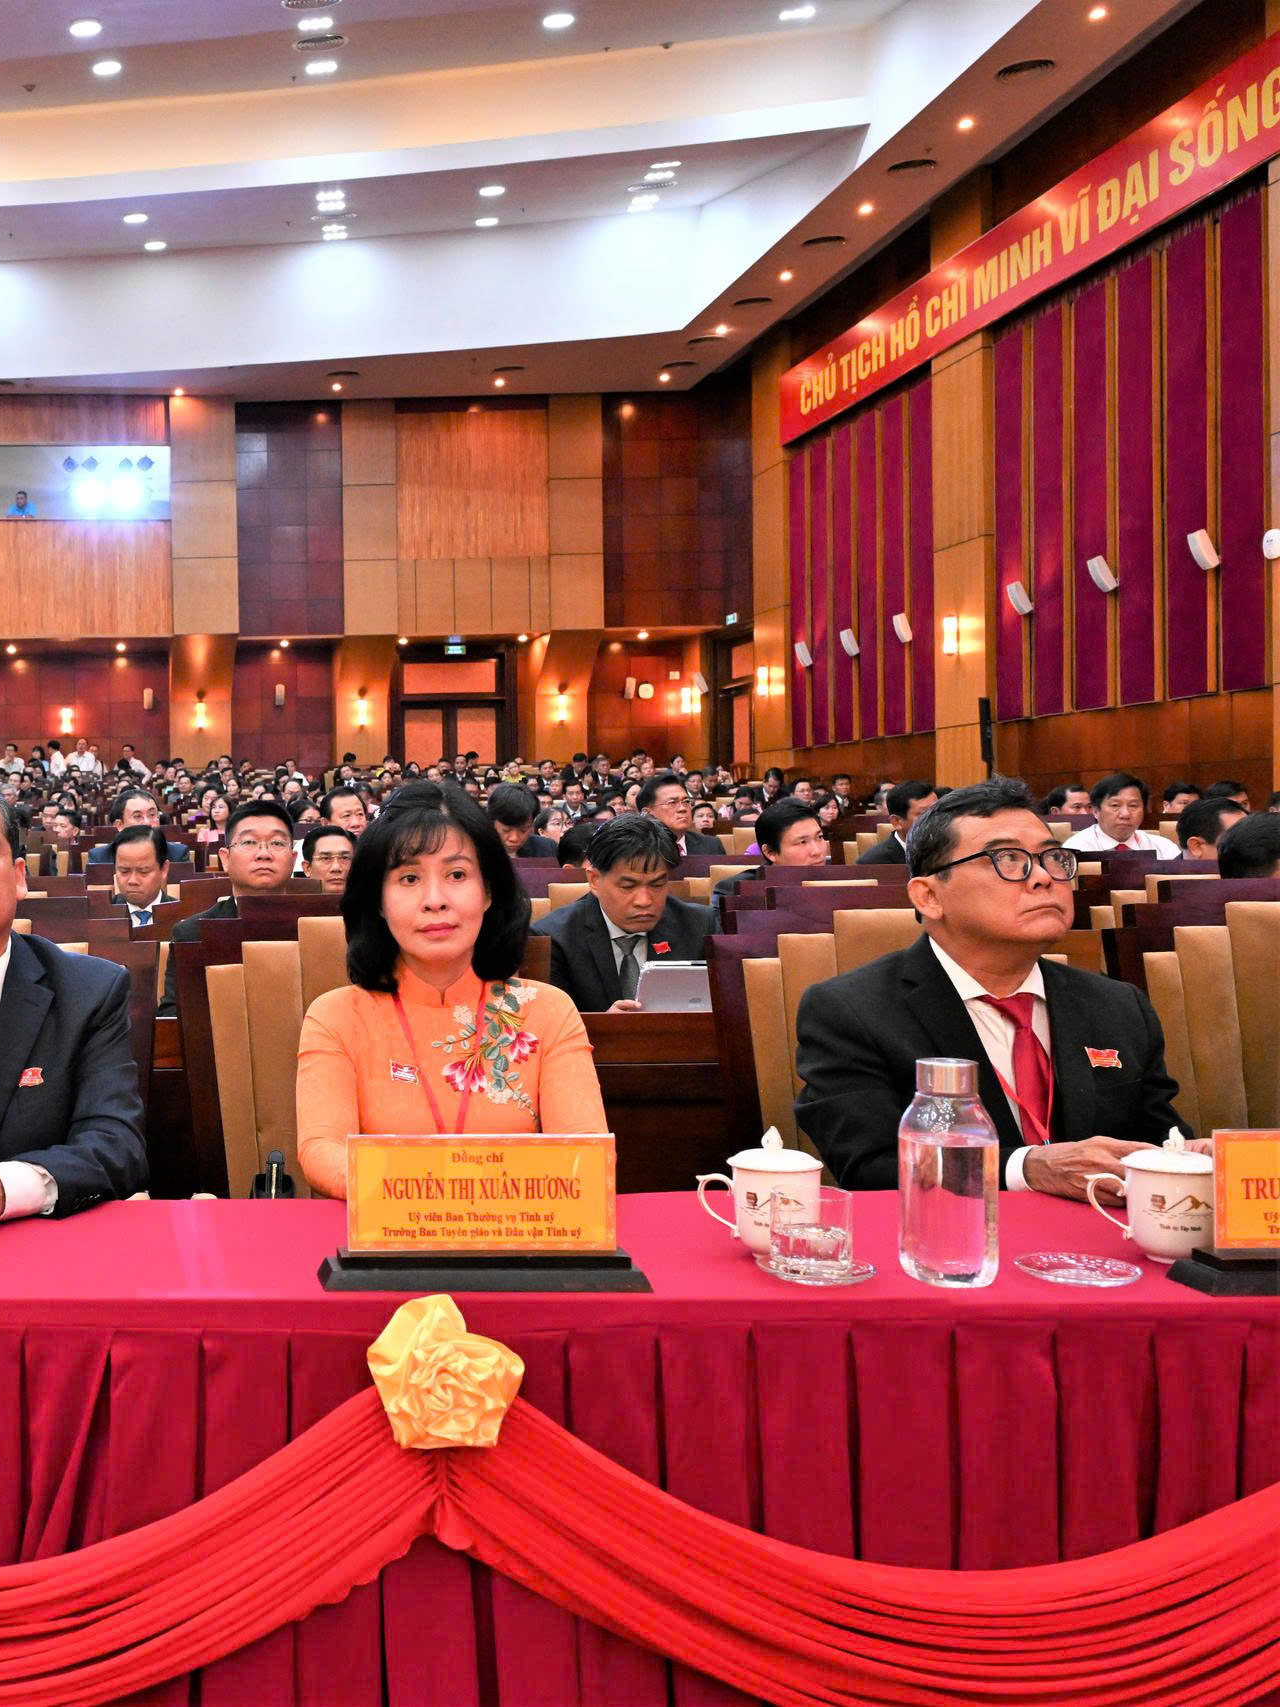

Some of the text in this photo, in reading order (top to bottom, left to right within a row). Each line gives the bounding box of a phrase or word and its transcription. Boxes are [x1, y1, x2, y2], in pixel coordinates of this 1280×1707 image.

[800, 352, 836, 415] CHỦ
[839, 326, 885, 393] TỊCH
[890, 296, 920, 361] HỒ
[973, 221, 1053, 310] MINH
[1056, 184, 1092, 256] VĨ
[1097, 149, 1160, 234] ĐẠI
[1169, 66, 1280, 187] SỐNG
[486, 1152, 504, 1163] chí
[382, 1171, 581, 1206] NGUYỄN THỊ XUÂN HƯƠNG
[445, 1212, 464, 1222] Ban
[419, 1227, 438, 1237] Ban
